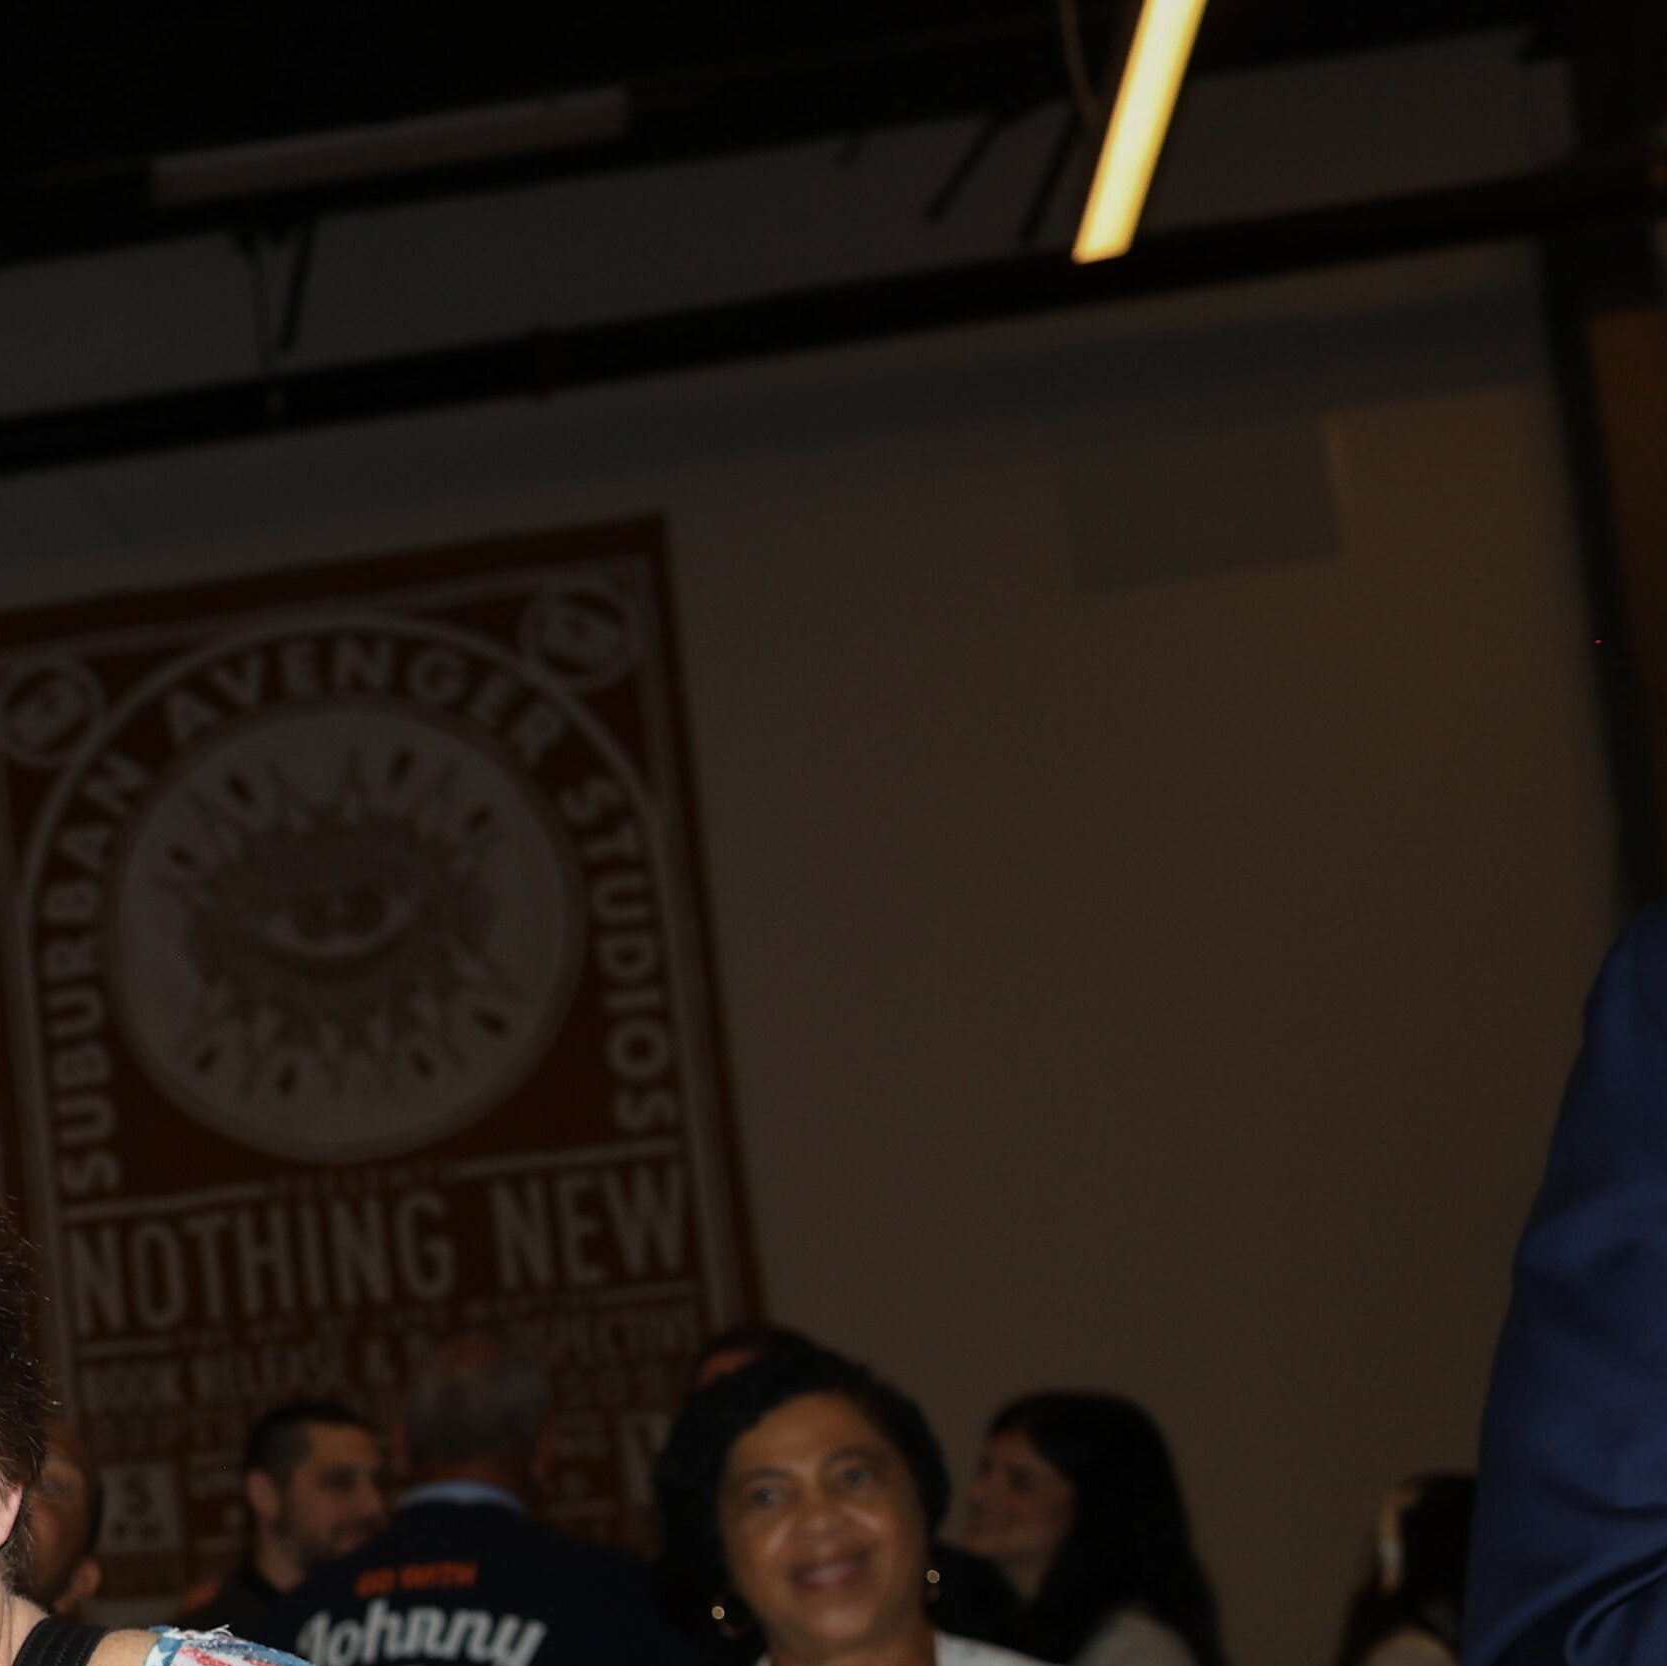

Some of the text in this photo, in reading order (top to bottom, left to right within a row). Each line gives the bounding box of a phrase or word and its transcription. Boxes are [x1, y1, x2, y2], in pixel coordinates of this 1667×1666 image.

[39, 634, 678, 1194] SUBURBAN AVENGER STUDIOS
[69, 1162, 691, 1340] NOTHING NEW
